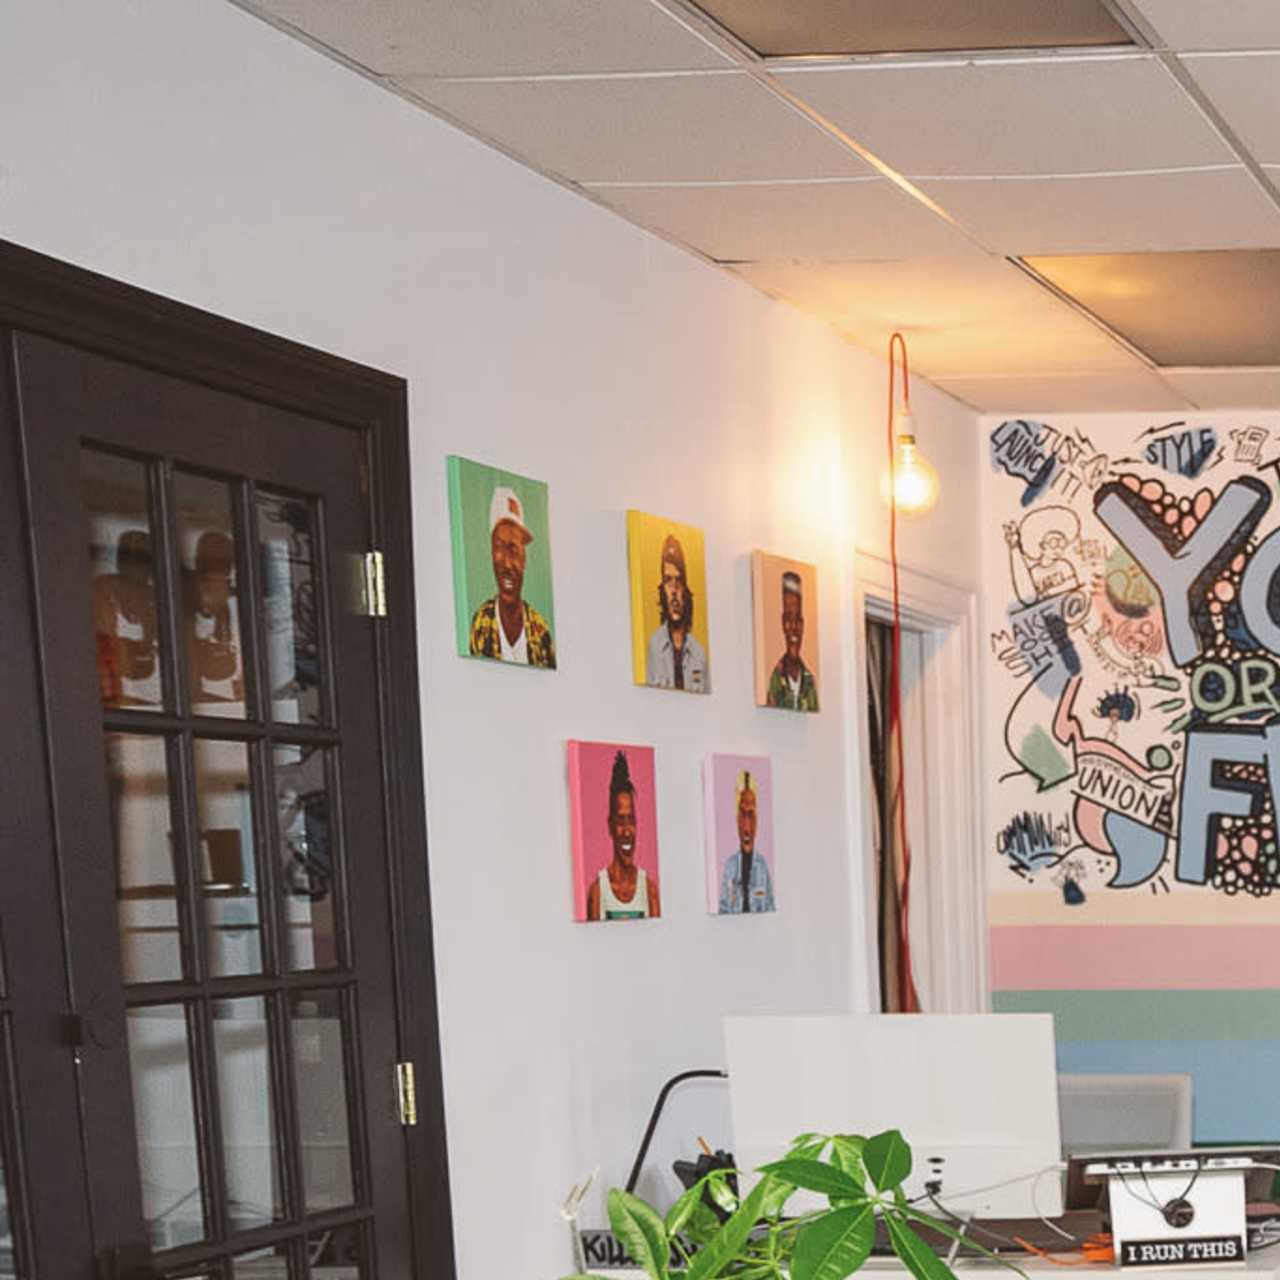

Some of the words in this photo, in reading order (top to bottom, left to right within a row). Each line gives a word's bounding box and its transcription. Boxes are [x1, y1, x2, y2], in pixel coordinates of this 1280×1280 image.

[1146, 428, 1213, 473] STYLE
[1078, 766, 1159, 818] UNION
[1128, 1246, 1137, 1261] I
[1141, 1244, 1185, 1261] RUN
[1188, 1241, 1238, 1258] THIS
